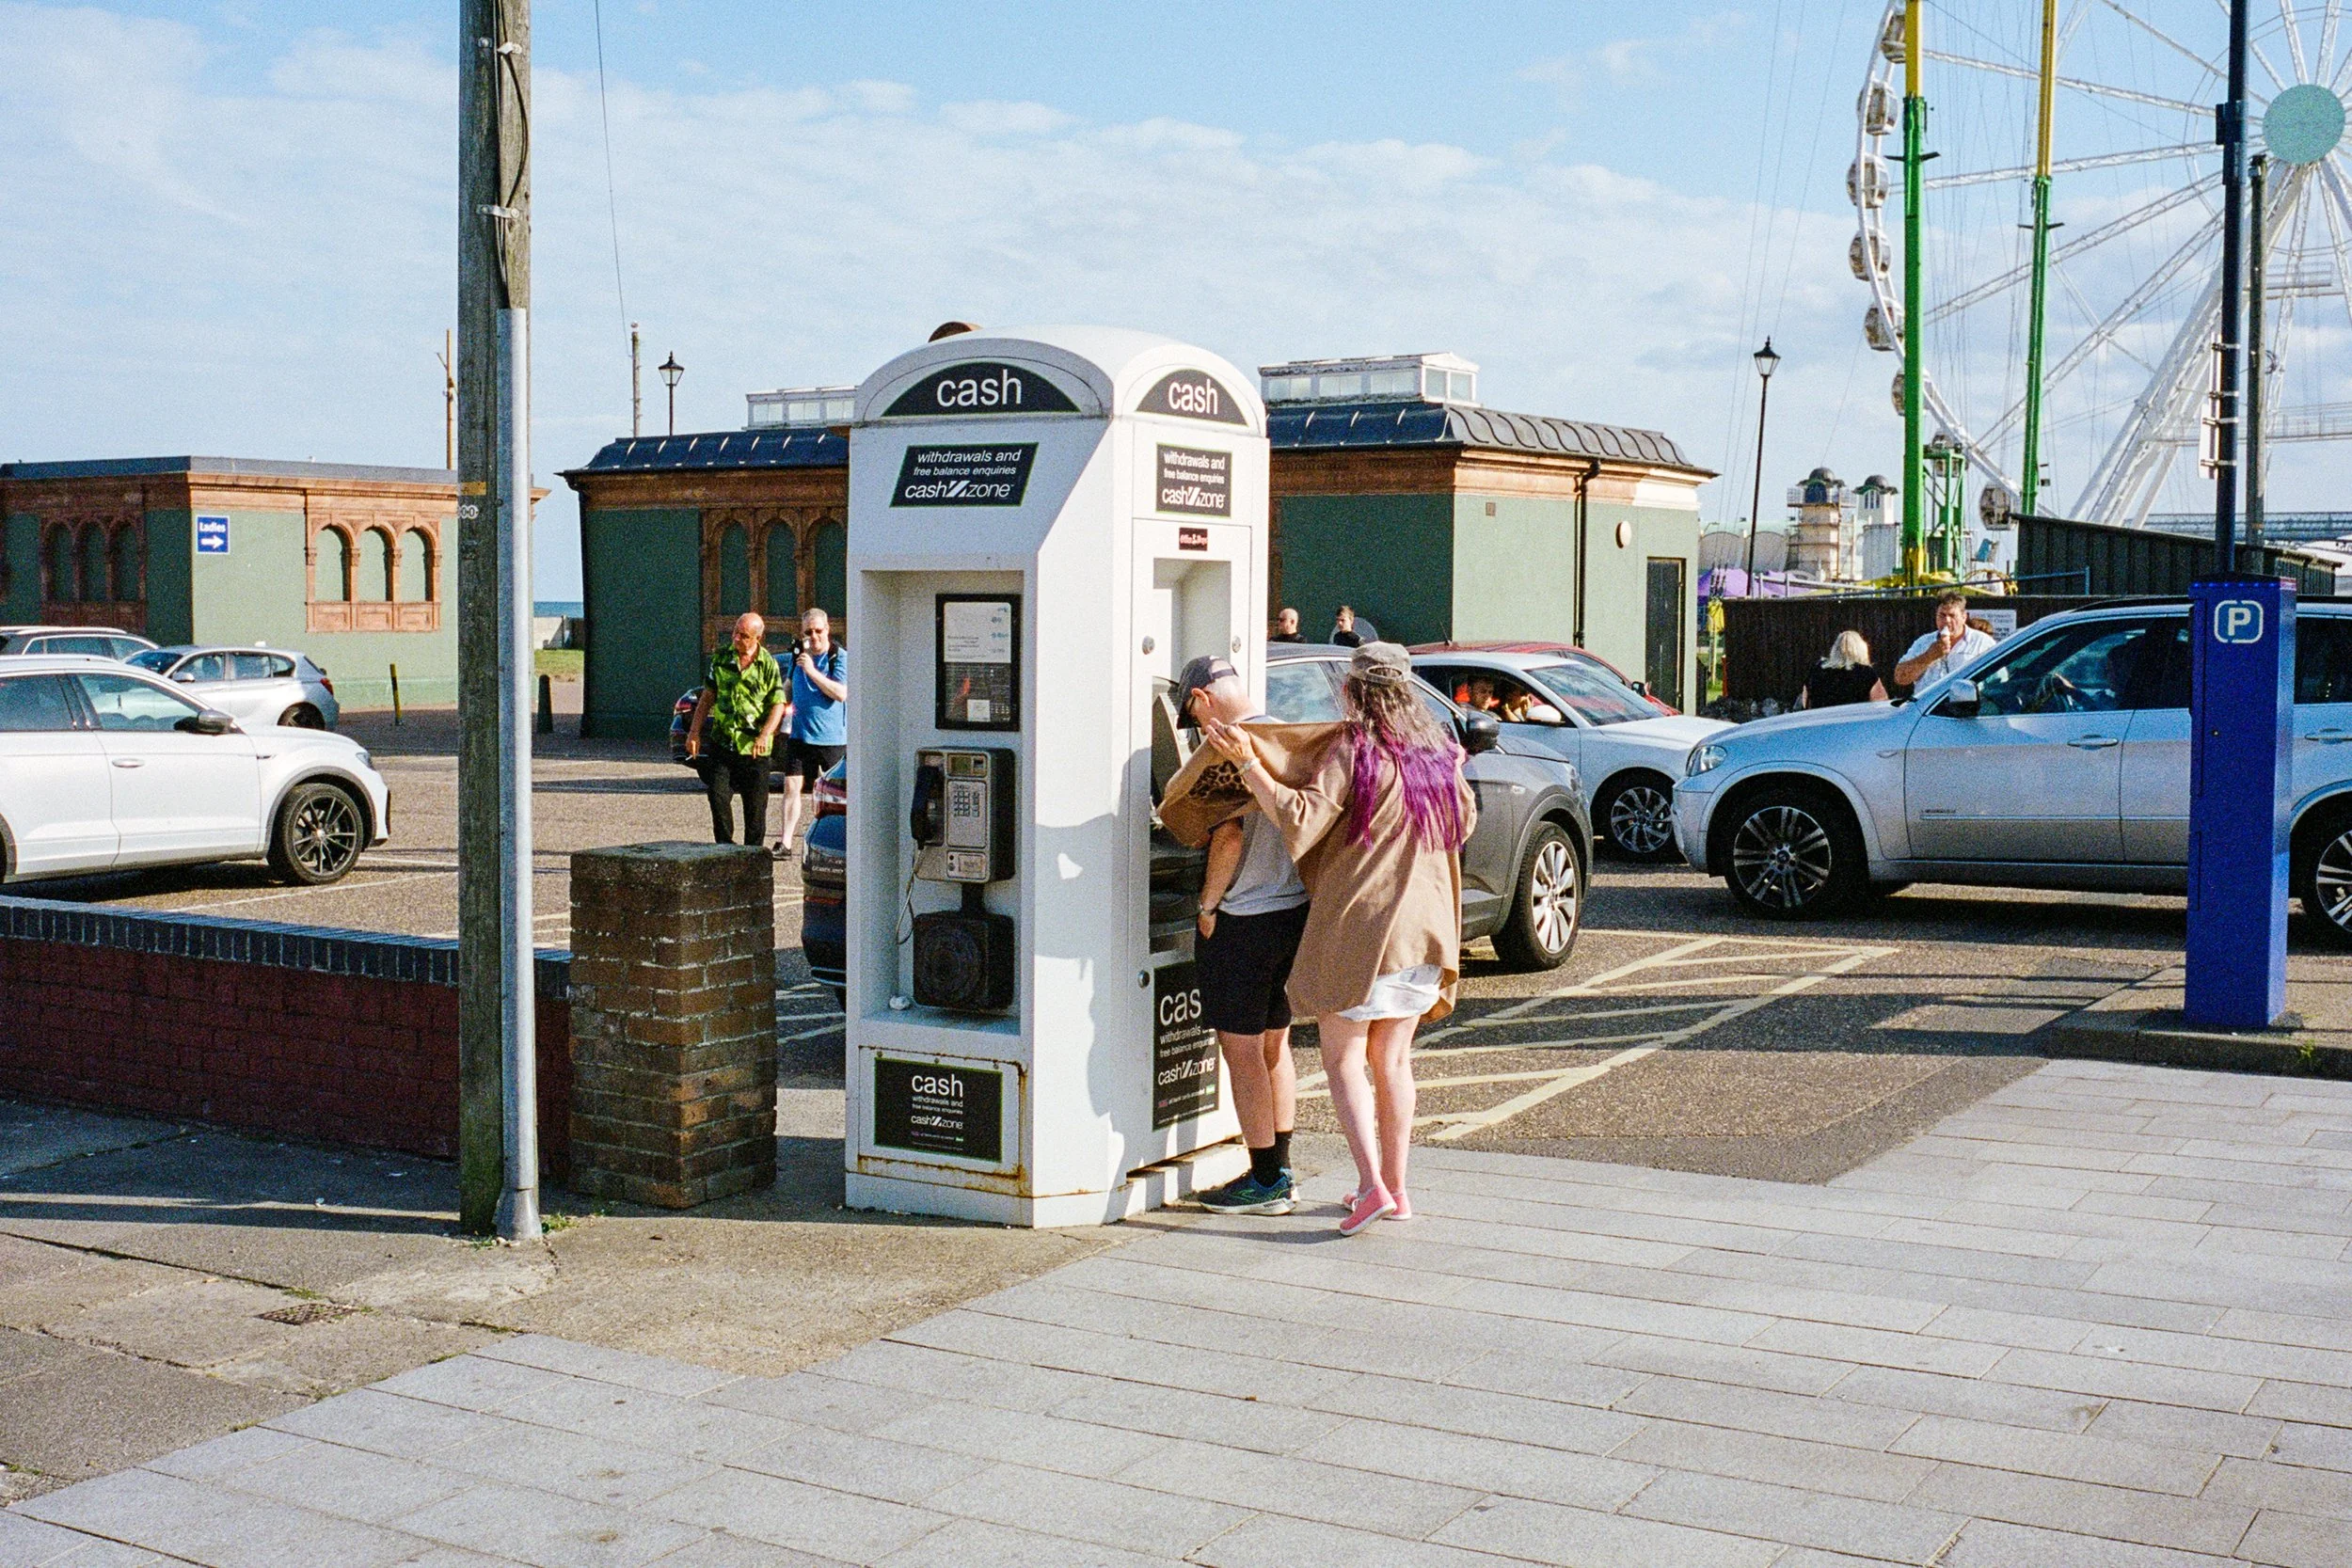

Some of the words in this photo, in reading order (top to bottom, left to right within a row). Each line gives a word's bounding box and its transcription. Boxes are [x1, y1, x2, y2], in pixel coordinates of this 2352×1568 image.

[936, 369, 1022, 407] cash
[1168, 378, 1218, 415] cash
[917, 450, 993, 463] withdrawals
[994, 449, 1022, 462] and
[1163, 451, 1210, 469] withdrawals
[1211, 456, 1225, 470] and
[913, 467, 931, 476] free
[932, 466, 971, 476] balance
[972, 465, 1017, 477] enquiries
[1164, 467, 1176, 479] free
[1176, 469, 1199, 482] balance
[1200, 473, 1225, 484] enquiries
[199, 521, 226, 532] Ladies
[2228, 608, 2251, 636] P
[1159, 989, 1202, 1026] cas
[1159, 1024, 1201, 1045] withdrawals
[911, 1073, 963, 1098] cash
[912, 1096, 949, 1106] withdrawals
